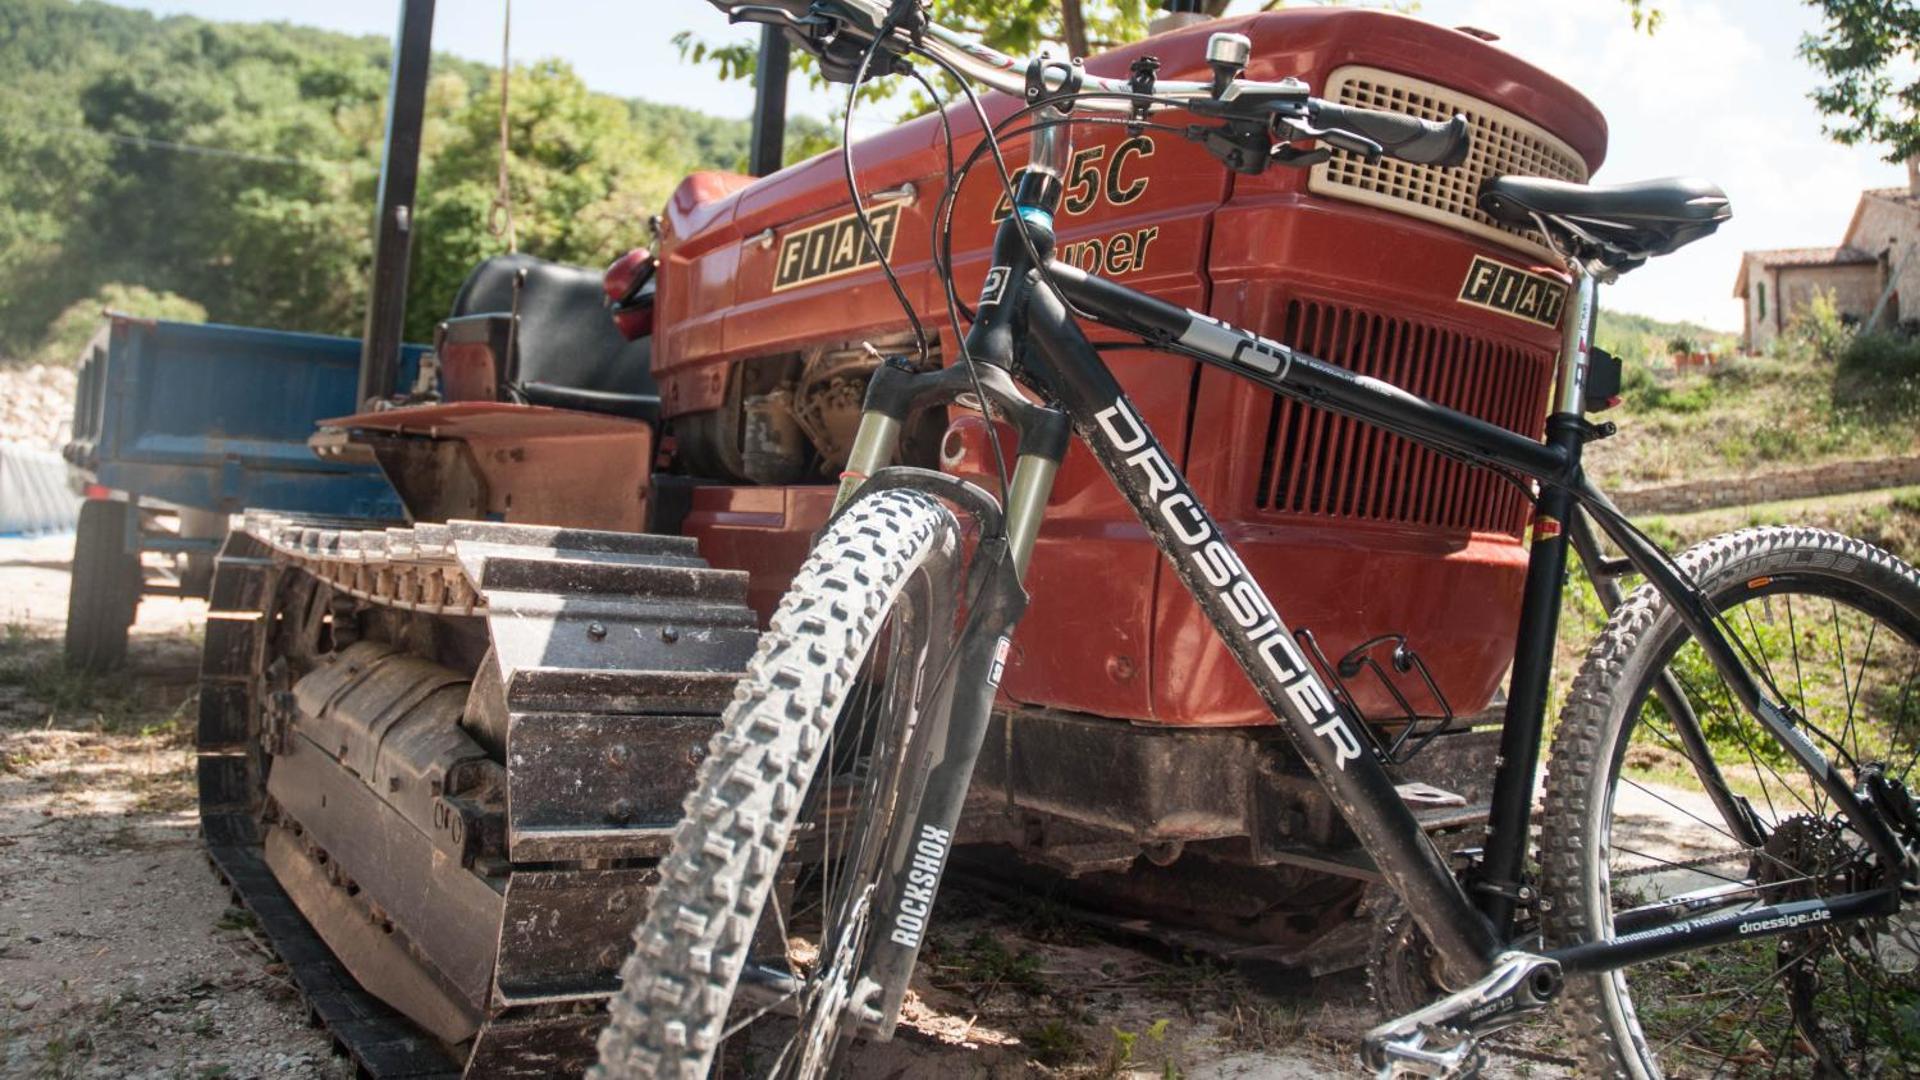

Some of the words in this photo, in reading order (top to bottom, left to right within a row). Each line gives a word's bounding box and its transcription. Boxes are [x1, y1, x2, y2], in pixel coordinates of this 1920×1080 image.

[782, 212, 892, 279] FIAT
[1053, 226, 1159, 277] uper
[1470, 266, 1561, 318] FIAT
[890, 824, 950, 948] ROCKSHOX
